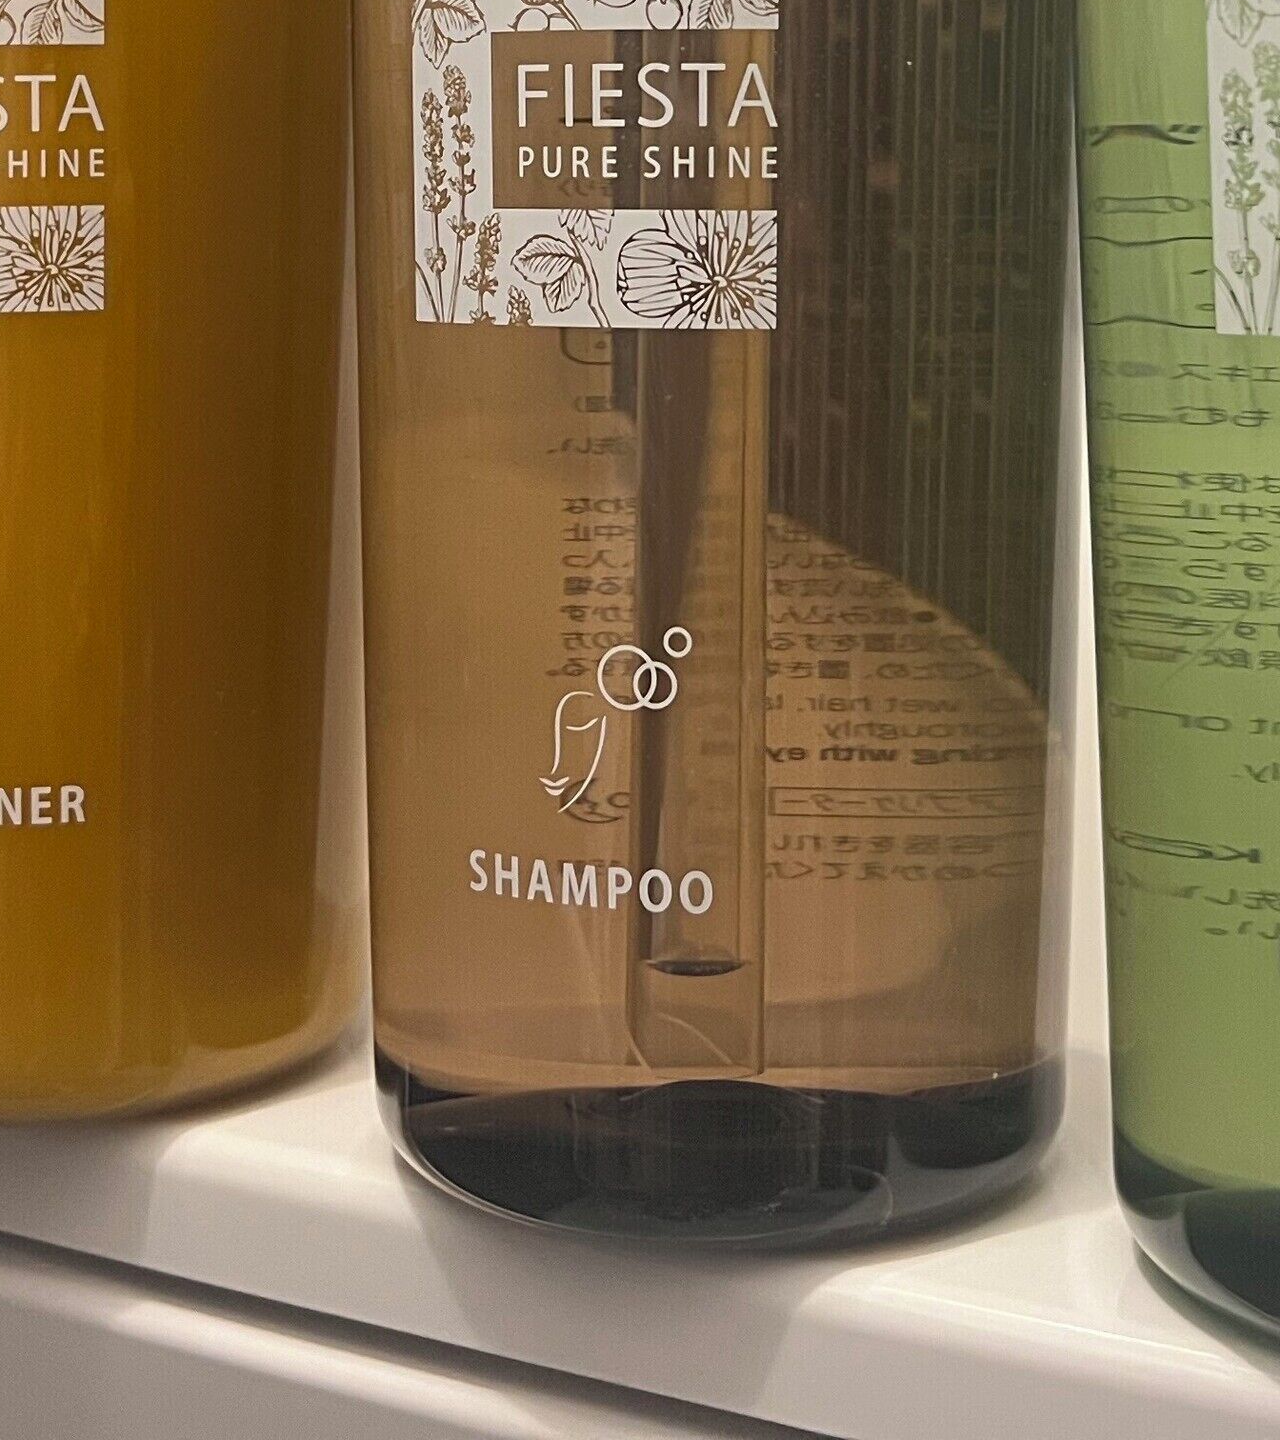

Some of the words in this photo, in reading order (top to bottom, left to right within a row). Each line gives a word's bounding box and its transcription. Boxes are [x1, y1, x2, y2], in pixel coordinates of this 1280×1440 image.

[516, 62, 778, 129] FIESTA
[518, 146, 619, 179] PURE
[643, 146, 778, 179] SHINE
[469, 848, 714, 915] SHAMPOO
